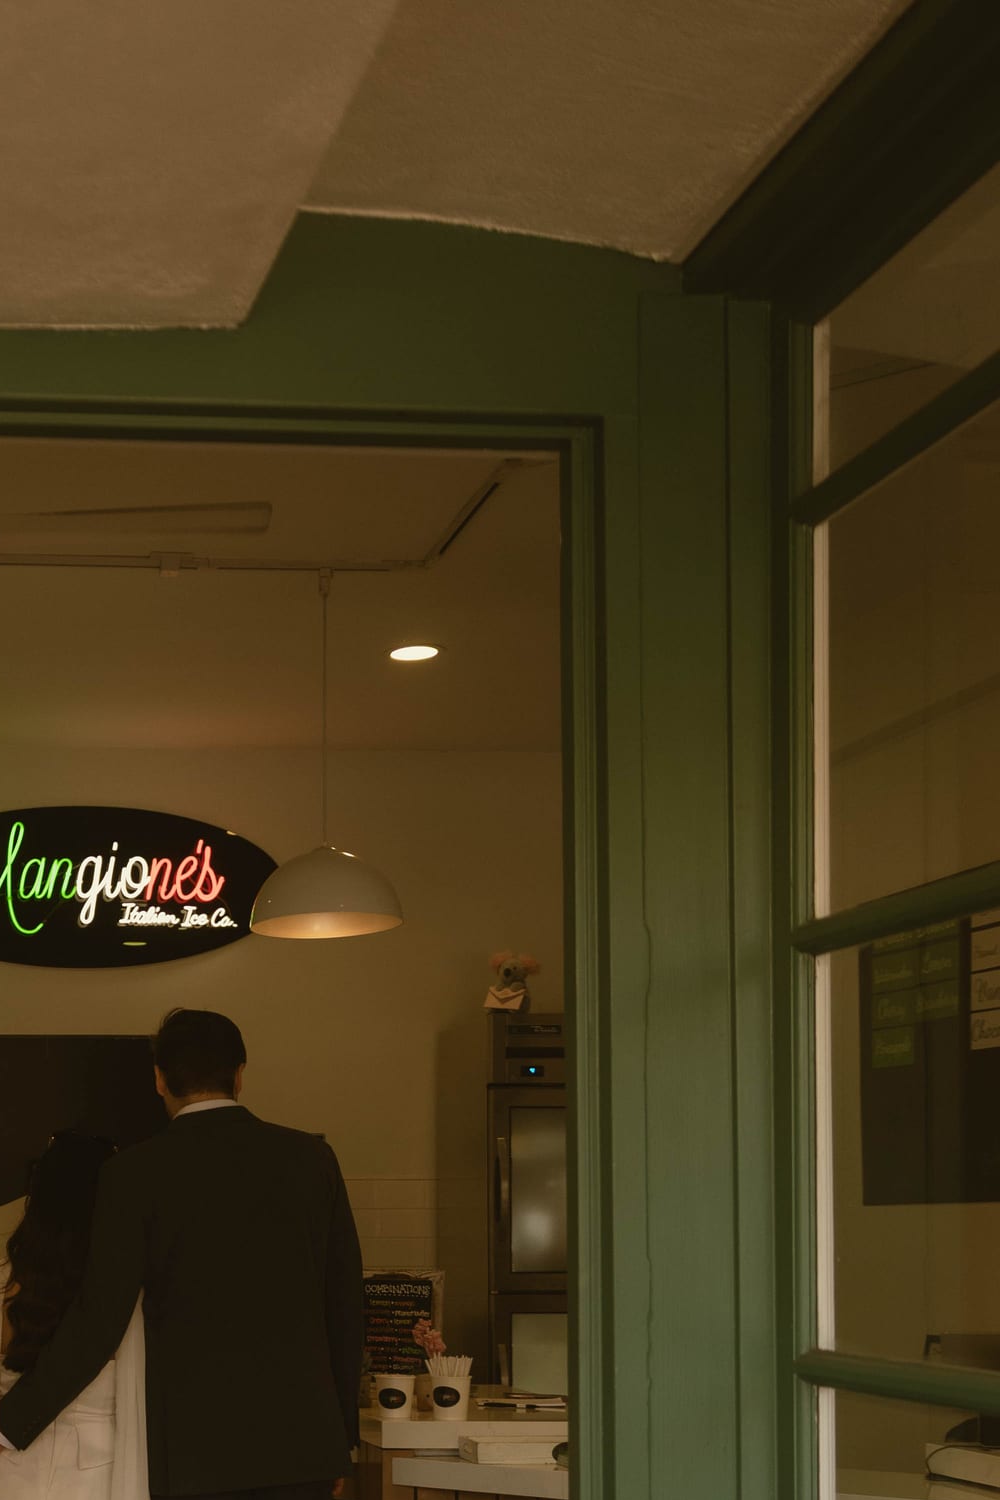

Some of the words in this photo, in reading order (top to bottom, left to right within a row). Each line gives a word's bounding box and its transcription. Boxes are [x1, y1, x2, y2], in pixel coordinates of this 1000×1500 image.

[119, 902, 181, 925] Italian
[179, 905, 210, 928] Ice
[210, 907, 239, 928] Co.
[365, 1284, 431, 1296] COMBINATIONS
